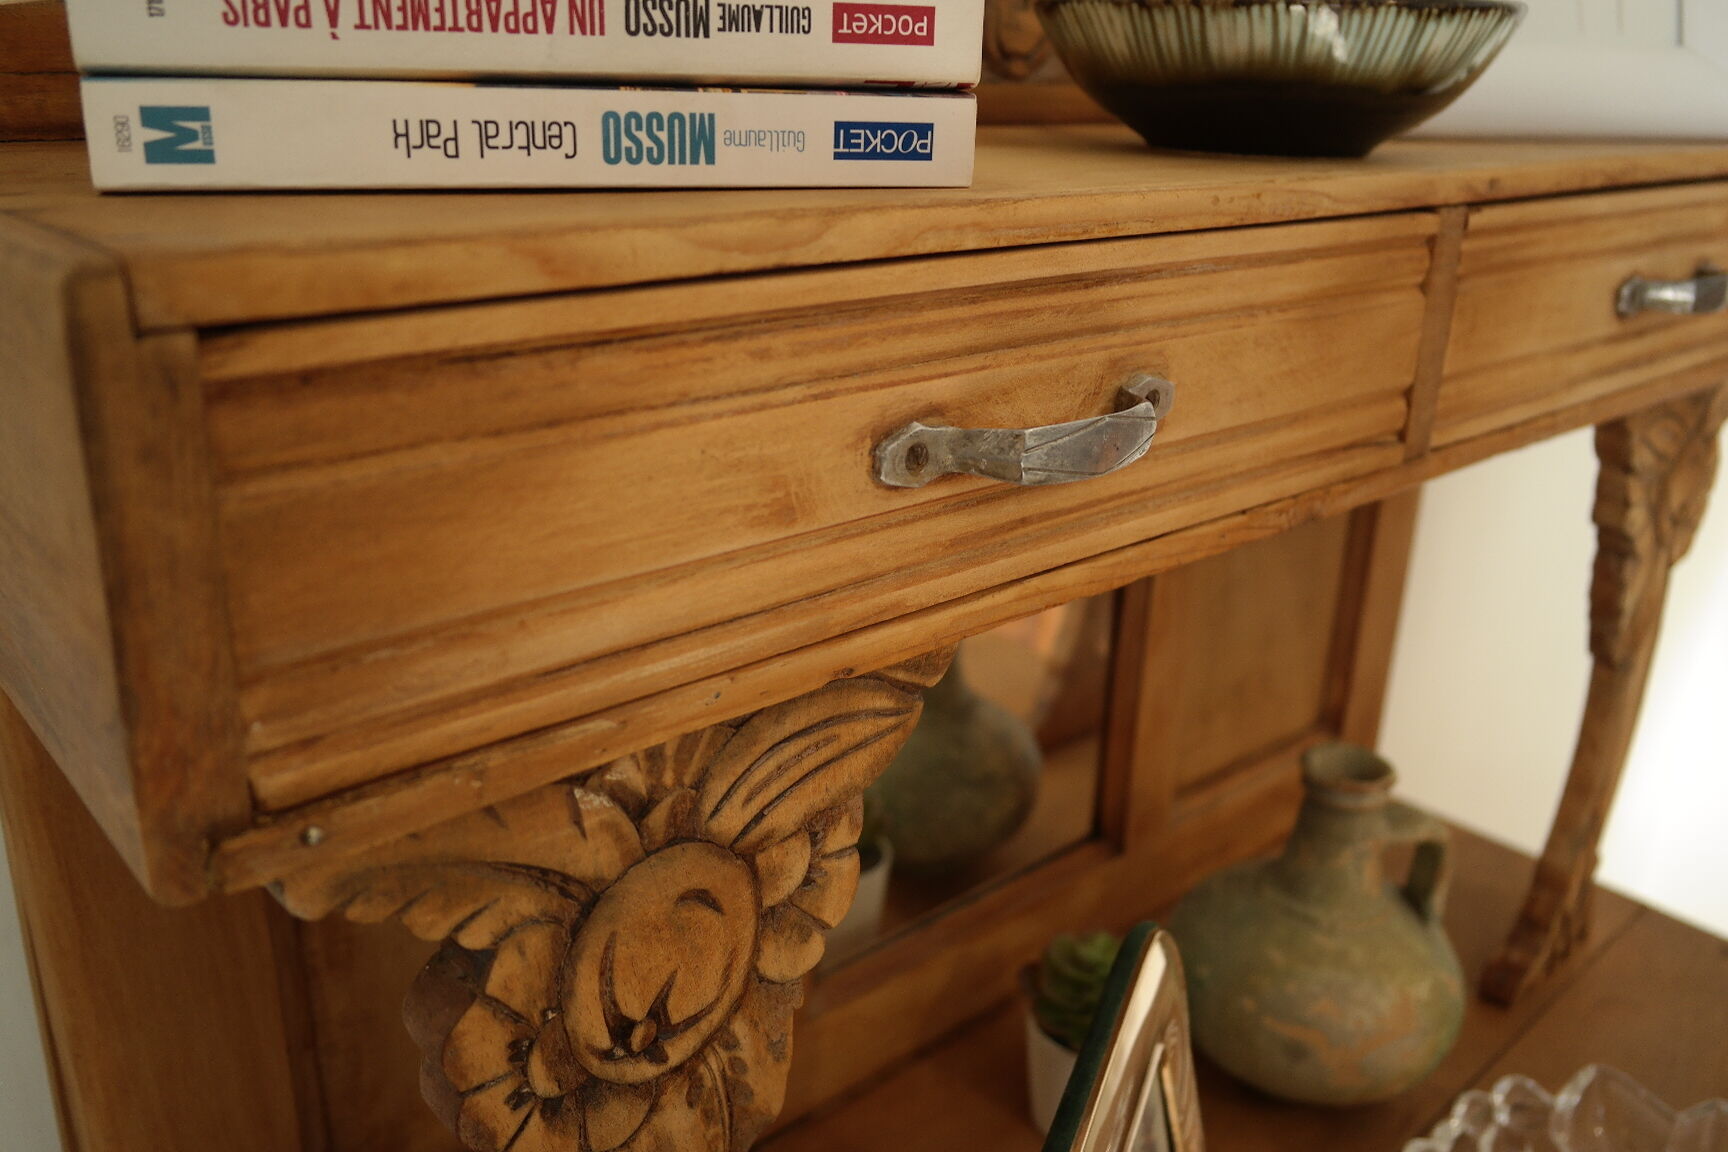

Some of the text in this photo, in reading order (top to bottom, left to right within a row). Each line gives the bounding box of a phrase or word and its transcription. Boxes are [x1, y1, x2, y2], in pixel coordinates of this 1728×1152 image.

[221, 0, 313, 29] PARIS
[353, 0, 558, 35] APPARTEMENT
[568, 0, 606, 36] UN
[625, 0, 812, 39] GUILLAUME MUSSO
[392, 118, 578, 160] Central Park
[601, 110, 805, 166] Guillaume MUSSO
[833, 128, 932, 154] POCKET
